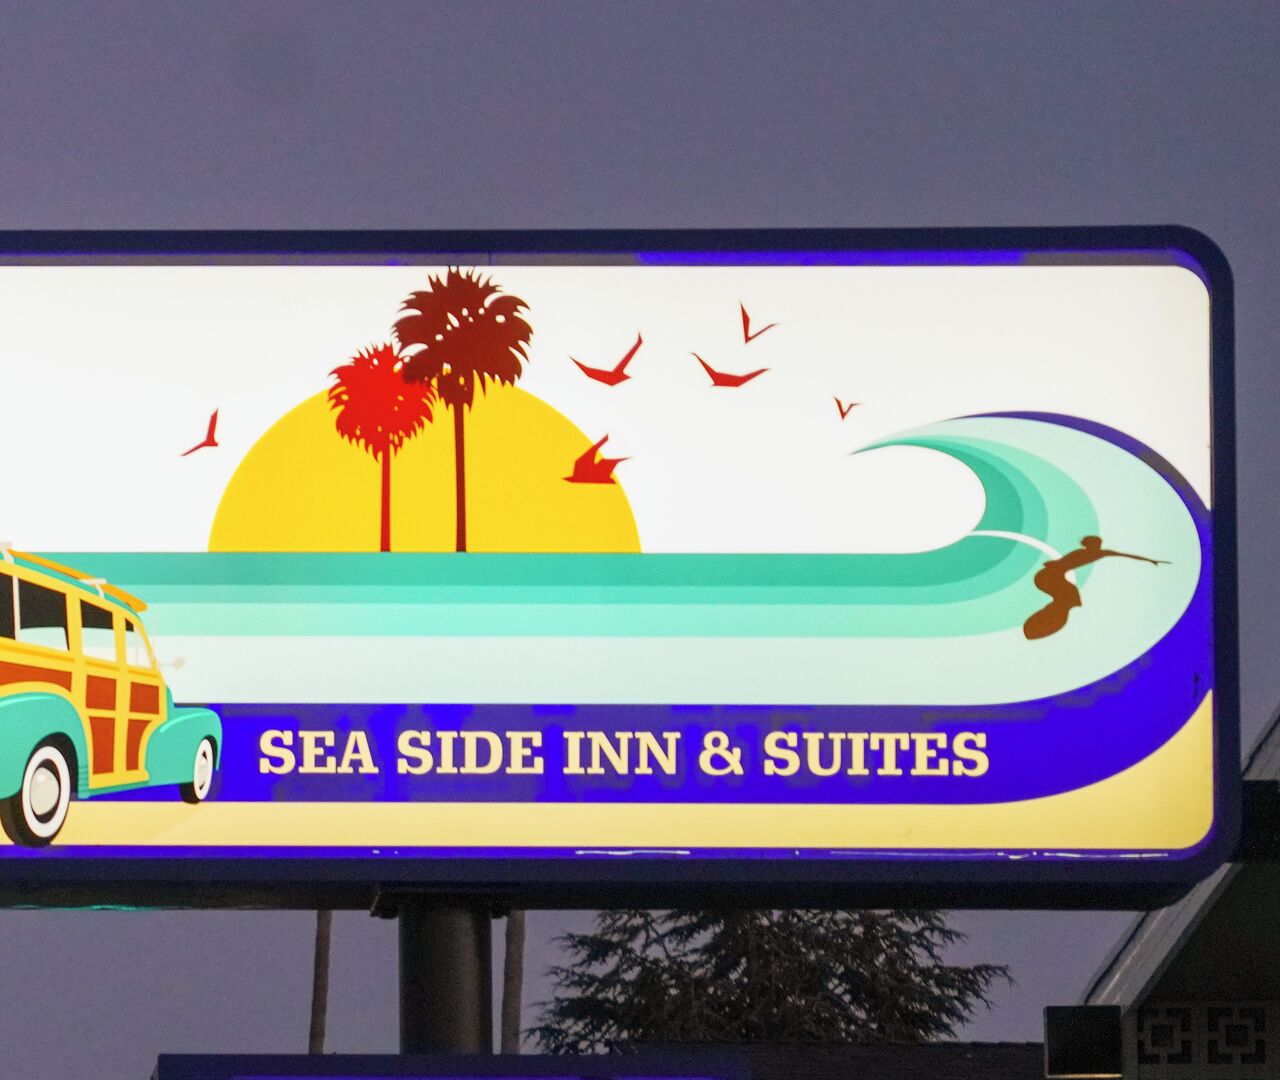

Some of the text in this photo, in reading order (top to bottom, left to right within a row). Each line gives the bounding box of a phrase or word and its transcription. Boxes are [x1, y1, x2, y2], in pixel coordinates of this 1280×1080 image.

[258, 728, 991, 778] SEA SIDE INN & SUITES
